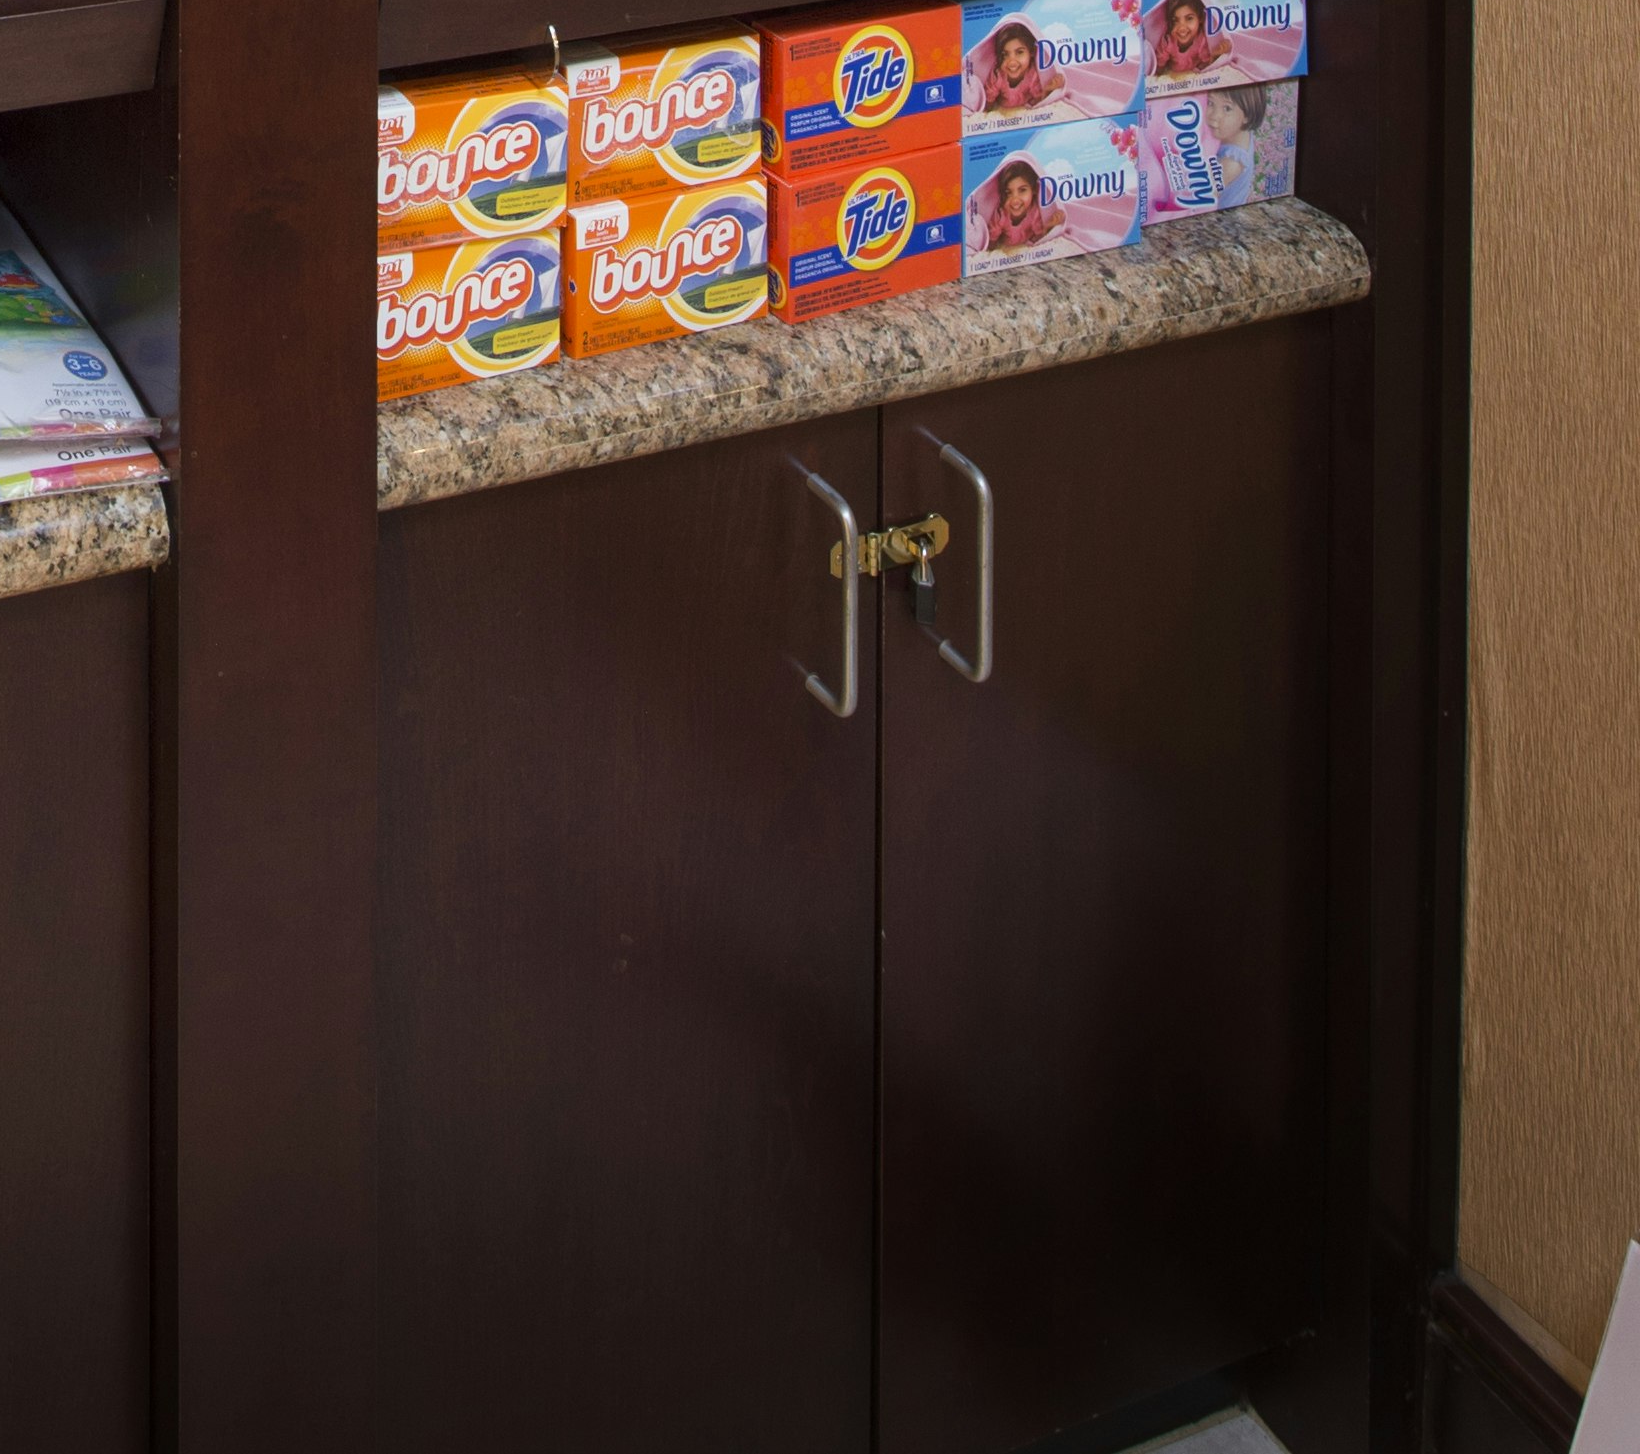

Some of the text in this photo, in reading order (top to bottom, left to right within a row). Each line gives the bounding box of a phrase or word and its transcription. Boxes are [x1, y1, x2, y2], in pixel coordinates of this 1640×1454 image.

[1037, 36, 1127, 70] Downy
[1206, 3, 1291, 35] Downy
[588, 73, 730, 155] bounce
[841, 48, 907, 117] Tide
[378, 126, 533, 205] bounce
[1039, 170, 1125, 207] Downy
[1167, 101, 1215, 207] Downy
[1208, 156, 1223, 192] ultra
[844, 189, 909, 261] Tide
[595, 221, 736, 304] bounce
[377, 263, 528, 351] bounce
[68, 359, 102, 370] 3-6
[58, 445, 132, 461] One Pair
